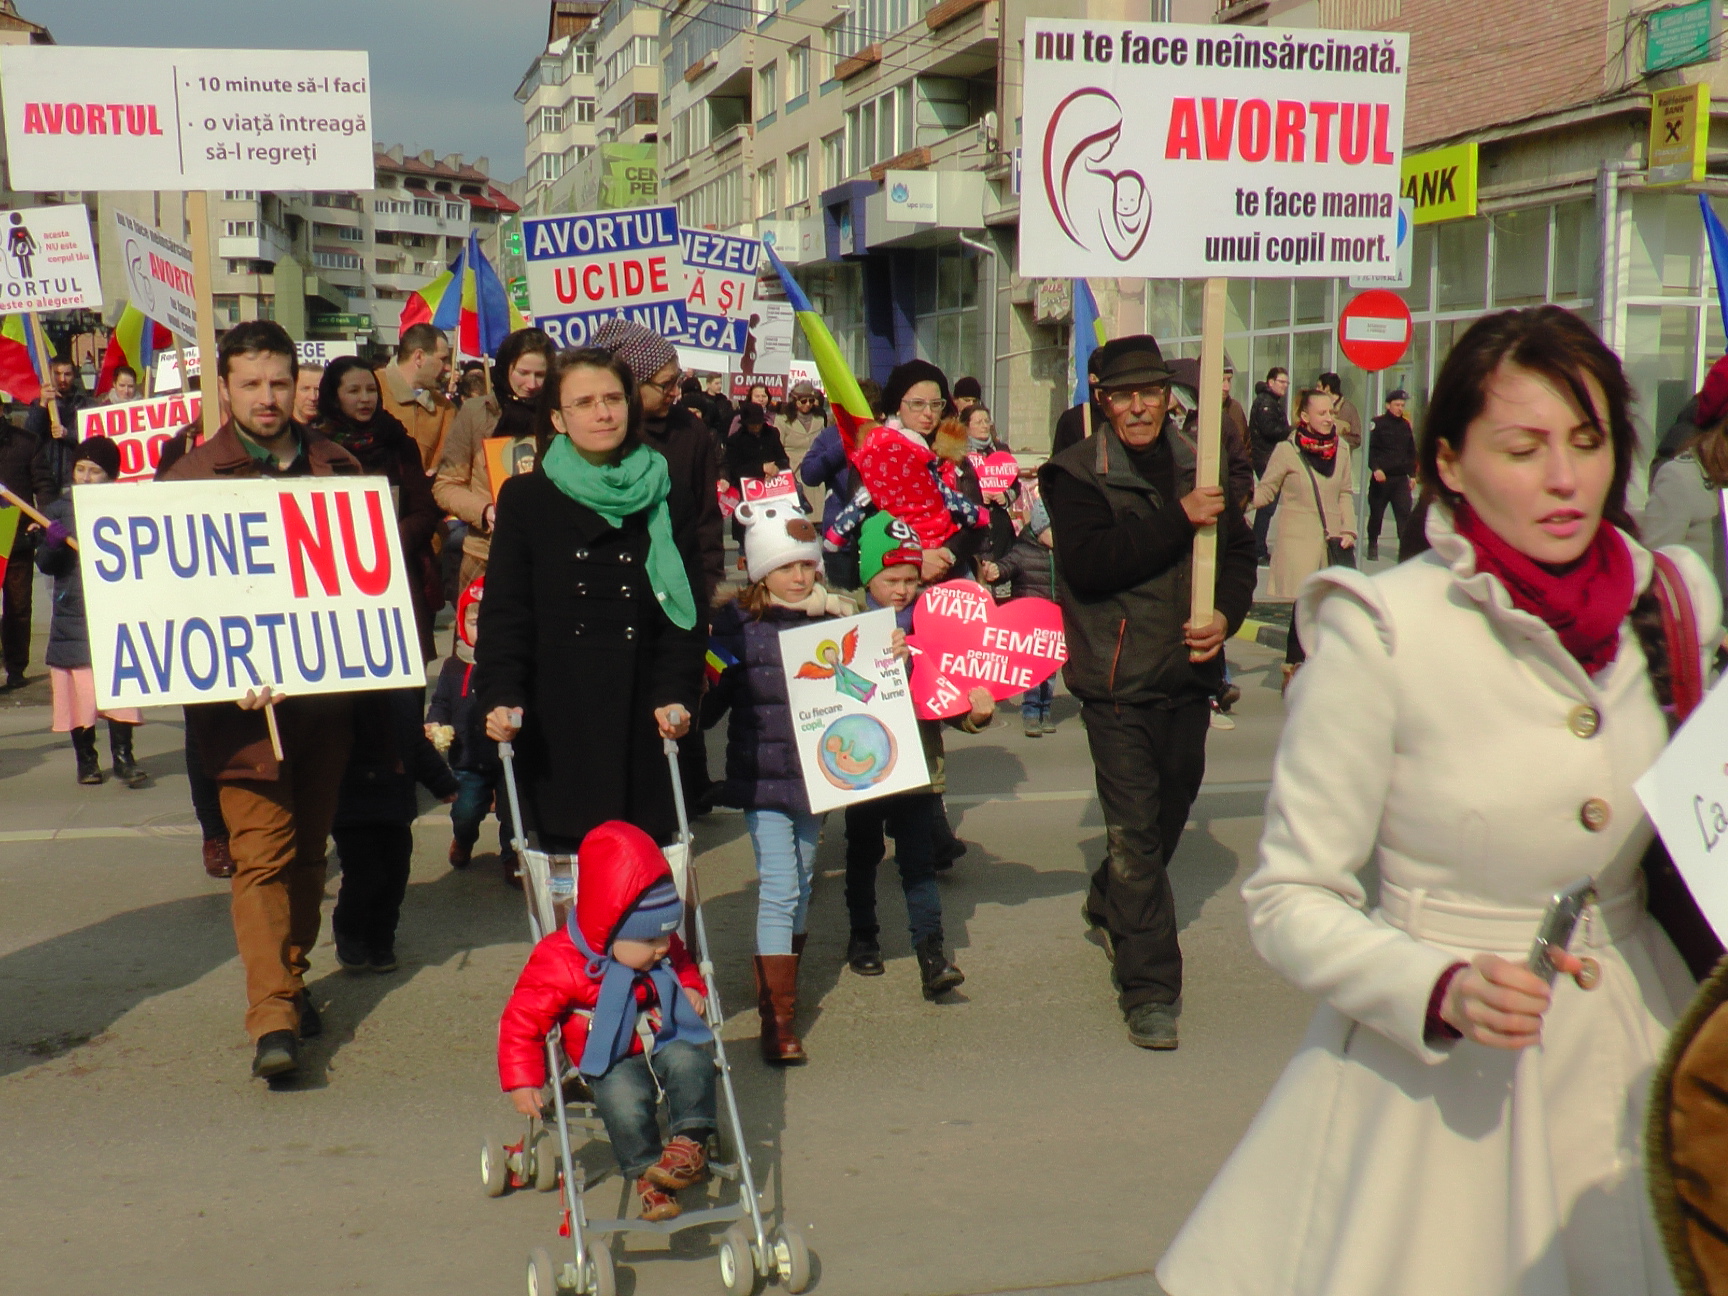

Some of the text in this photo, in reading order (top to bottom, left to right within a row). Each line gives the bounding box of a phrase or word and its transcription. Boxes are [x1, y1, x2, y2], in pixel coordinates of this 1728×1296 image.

[1035, 29, 1401, 74] nu te face neînsărcinată.
[199, 74, 367, 94] 10 minute să-l faci
[23, 103, 163, 136] AVORTUL
[204, 113, 366, 142] o viață întreagă
[1165, 97, 1394, 165] AVORTUL
[206, 143, 241, 161] să-l
[1236, 185, 1393, 218] te face mama
[1403, 165, 1459, 208] ANK
[46, 243, 59, 251] NU
[534, 213, 673, 256] AVORTUL
[1205, 231, 1390, 265] unui copil mort.
[680, 232, 759, 271] NEZEU
[0, 277, 82, 298] ORTUL
[554, 256, 670, 305] UCIDE
[681, 313, 737, 350] ECĂ
[92, 490, 391, 598] SPUNE NU
[925, 592, 988, 624] VIAȚĂ
[932, 586, 974, 600] pentru
[112, 607, 411, 697] AVORTULUI
[967, 649, 1009, 665] pentru
[982, 626, 1067, 661] FEMEIE
[880, 667, 900, 678] vine
[893, 676, 903, 686] în
[940, 653, 1033, 689] FAMILIE
[799, 702, 843, 721] Cu fiecare
[881, 689, 905, 701] lume
[801, 721, 826, 732] copil,
